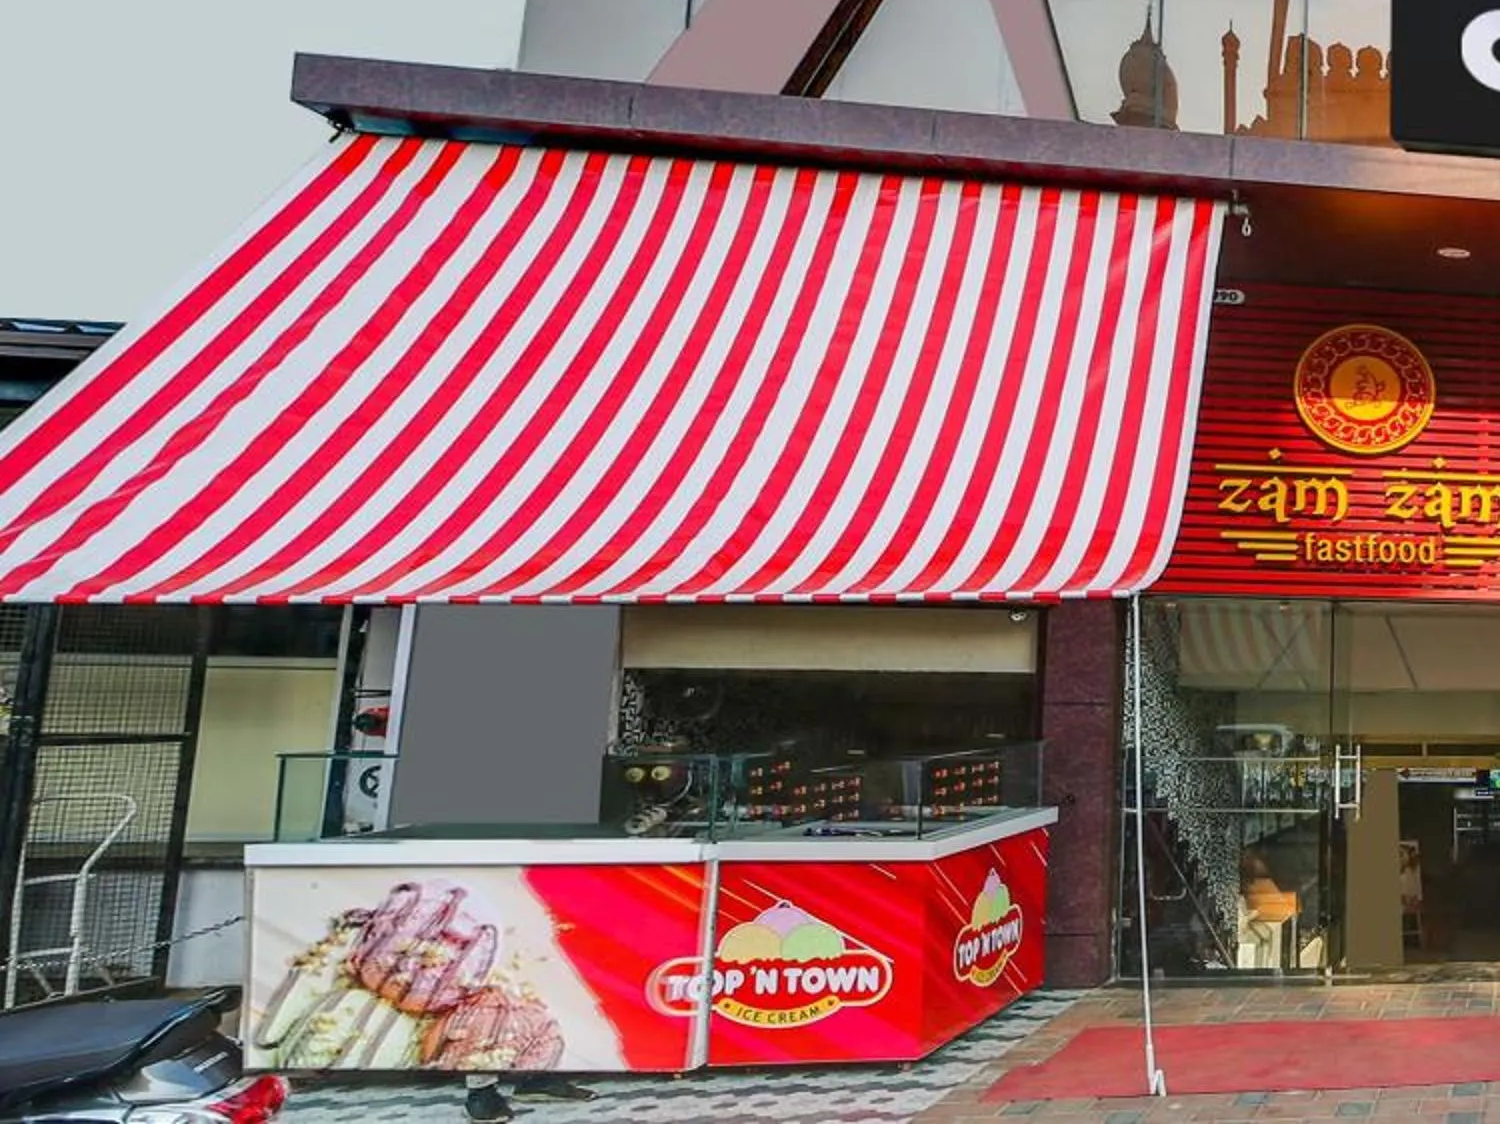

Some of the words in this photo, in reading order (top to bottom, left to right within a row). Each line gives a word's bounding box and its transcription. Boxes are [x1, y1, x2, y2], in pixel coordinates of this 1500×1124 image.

[1303, 532, 1437, 563] fastfood
[960, 937, 981, 968] TOP
[783, 966, 880, 994] TOWN
[735, 1007, 761, 1023] ICE
[767, 1005, 821, 1025] CREAM
